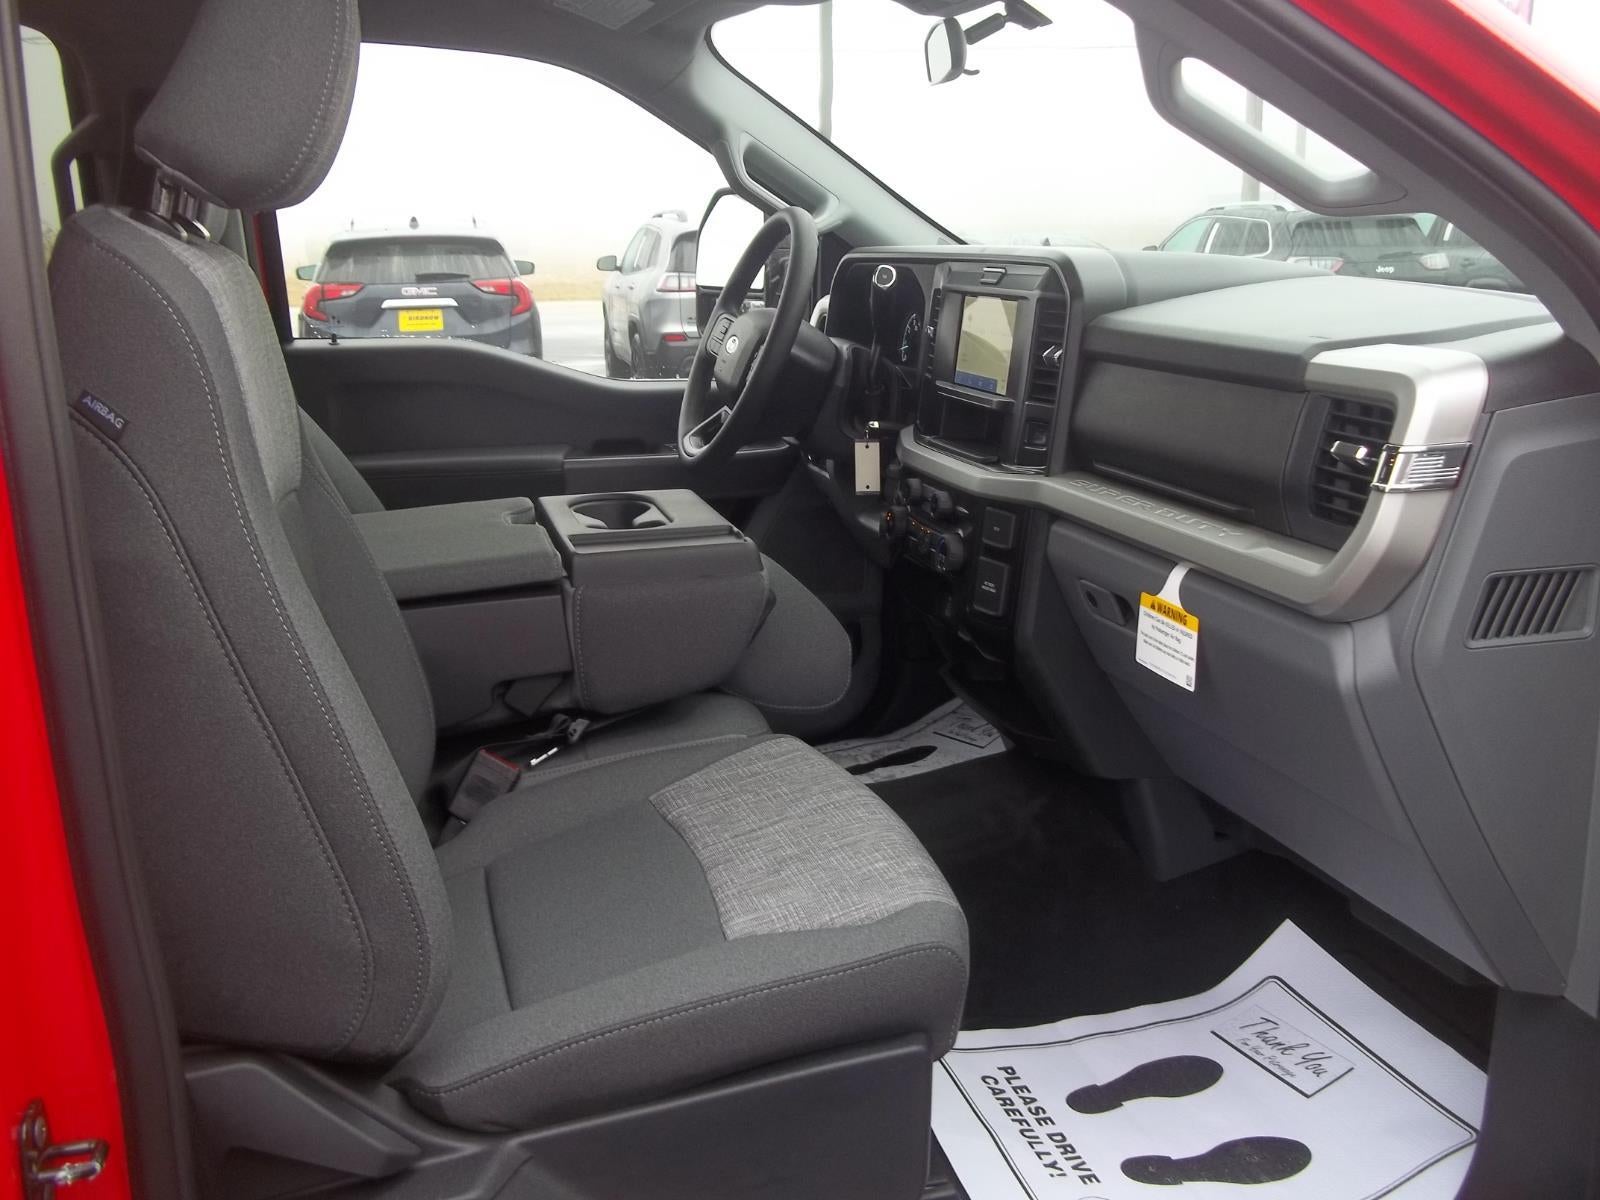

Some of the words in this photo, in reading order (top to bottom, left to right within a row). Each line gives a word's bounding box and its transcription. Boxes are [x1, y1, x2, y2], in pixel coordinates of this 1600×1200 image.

[401, 286, 438, 296] GMC
[1375, 265, 1395, 274] Jeep
[82, 395, 125, 429] AIRBAG
[1069, 479, 1155, 509] SUPER
[1154, 507, 1244, 537] DUTY
[1155, 601, 1188, 626] WARNING
[1239, 1016, 1310, 1056] Thank
[1294, 1051, 1334, 1078] You
[980, 1074, 1068, 1178] CAREFULLY!
[996, 1065, 1057, 1127] PLEASE
[1046, 1131, 1102, 1186] DRIVE
